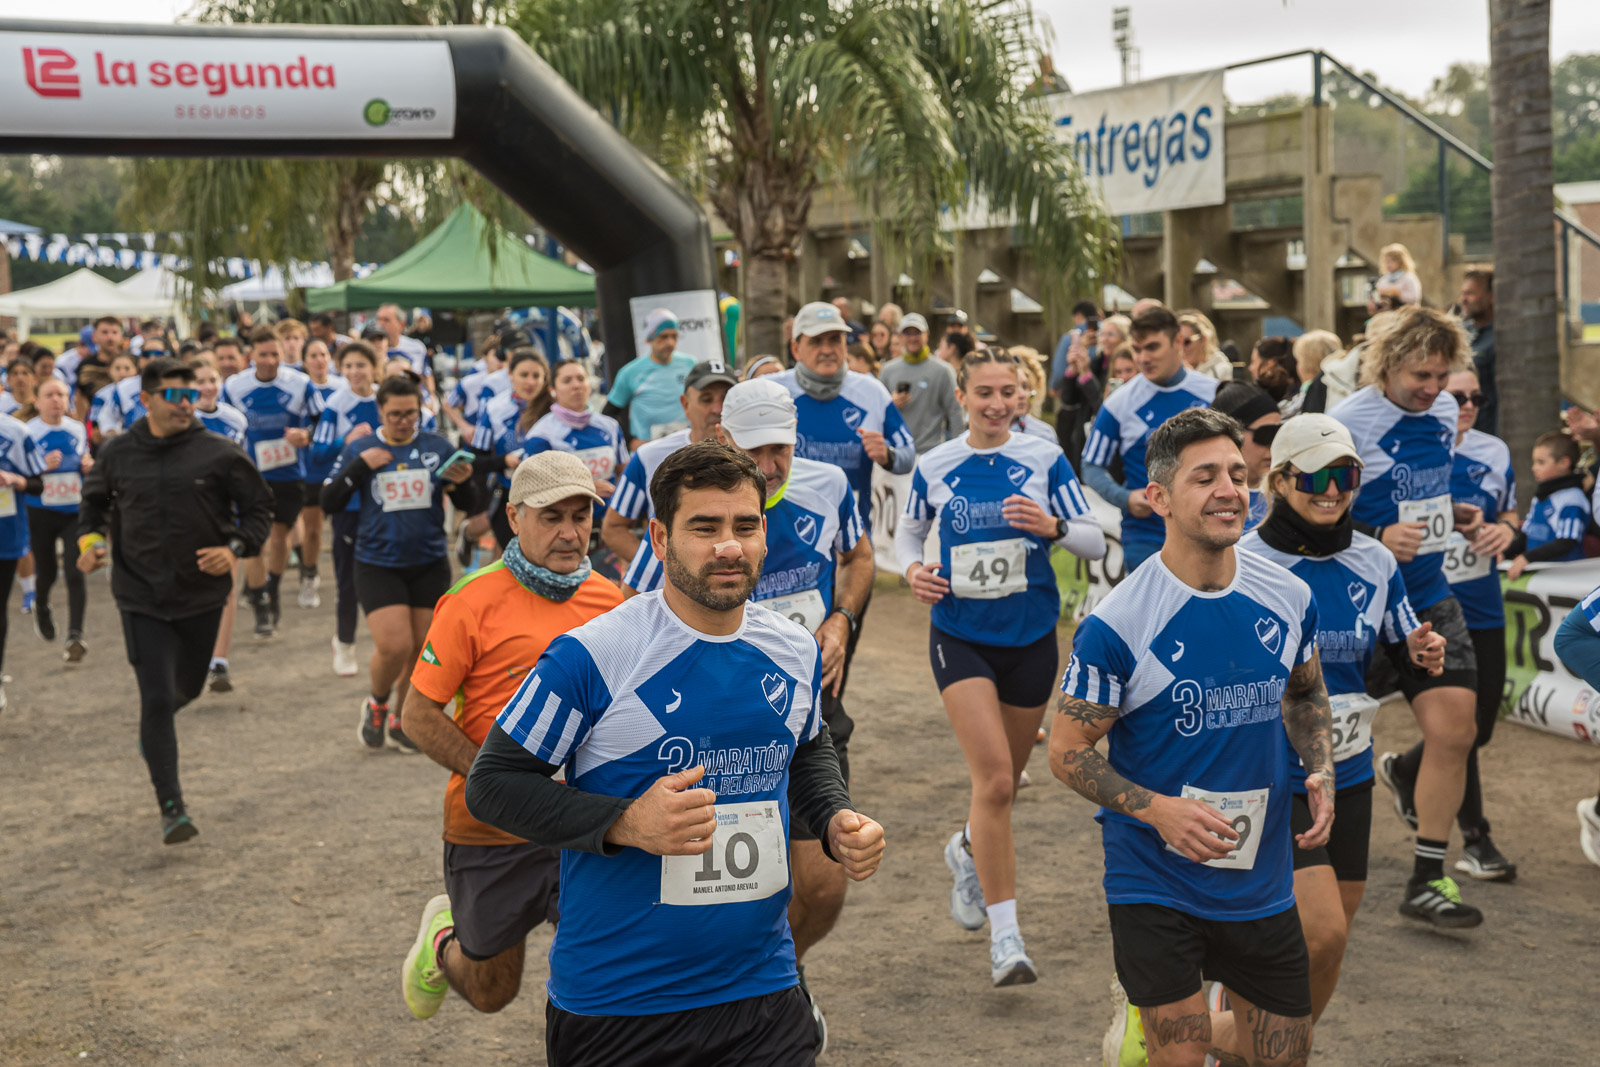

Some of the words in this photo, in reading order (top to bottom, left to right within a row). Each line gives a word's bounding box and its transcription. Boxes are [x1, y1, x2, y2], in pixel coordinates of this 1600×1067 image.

[95, 52, 137, 85] la
[149, 56, 336, 96] segunda
[174, 104, 266, 119] SEGUROS
[1055, 105, 1211, 188] ntregas
[588, 456, 610, 476] 29
[44, 481, 80, 498] 504
[385, 480, 424, 500] 519
[950, 496, 970, 534] 3
[969, 558, 1009, 586] 49
[1445, 546, 1477, 570] 36
[1172, 679, 1202, 736] 3
[697, 740, 788, 776] MARATÓN
[695, 832, 759, 880] 10
[693, 885, 714, 894] MANUEL
[715, 884, 736, 892] ANTONIO
[737, 882, 758, 891] AREVALO
